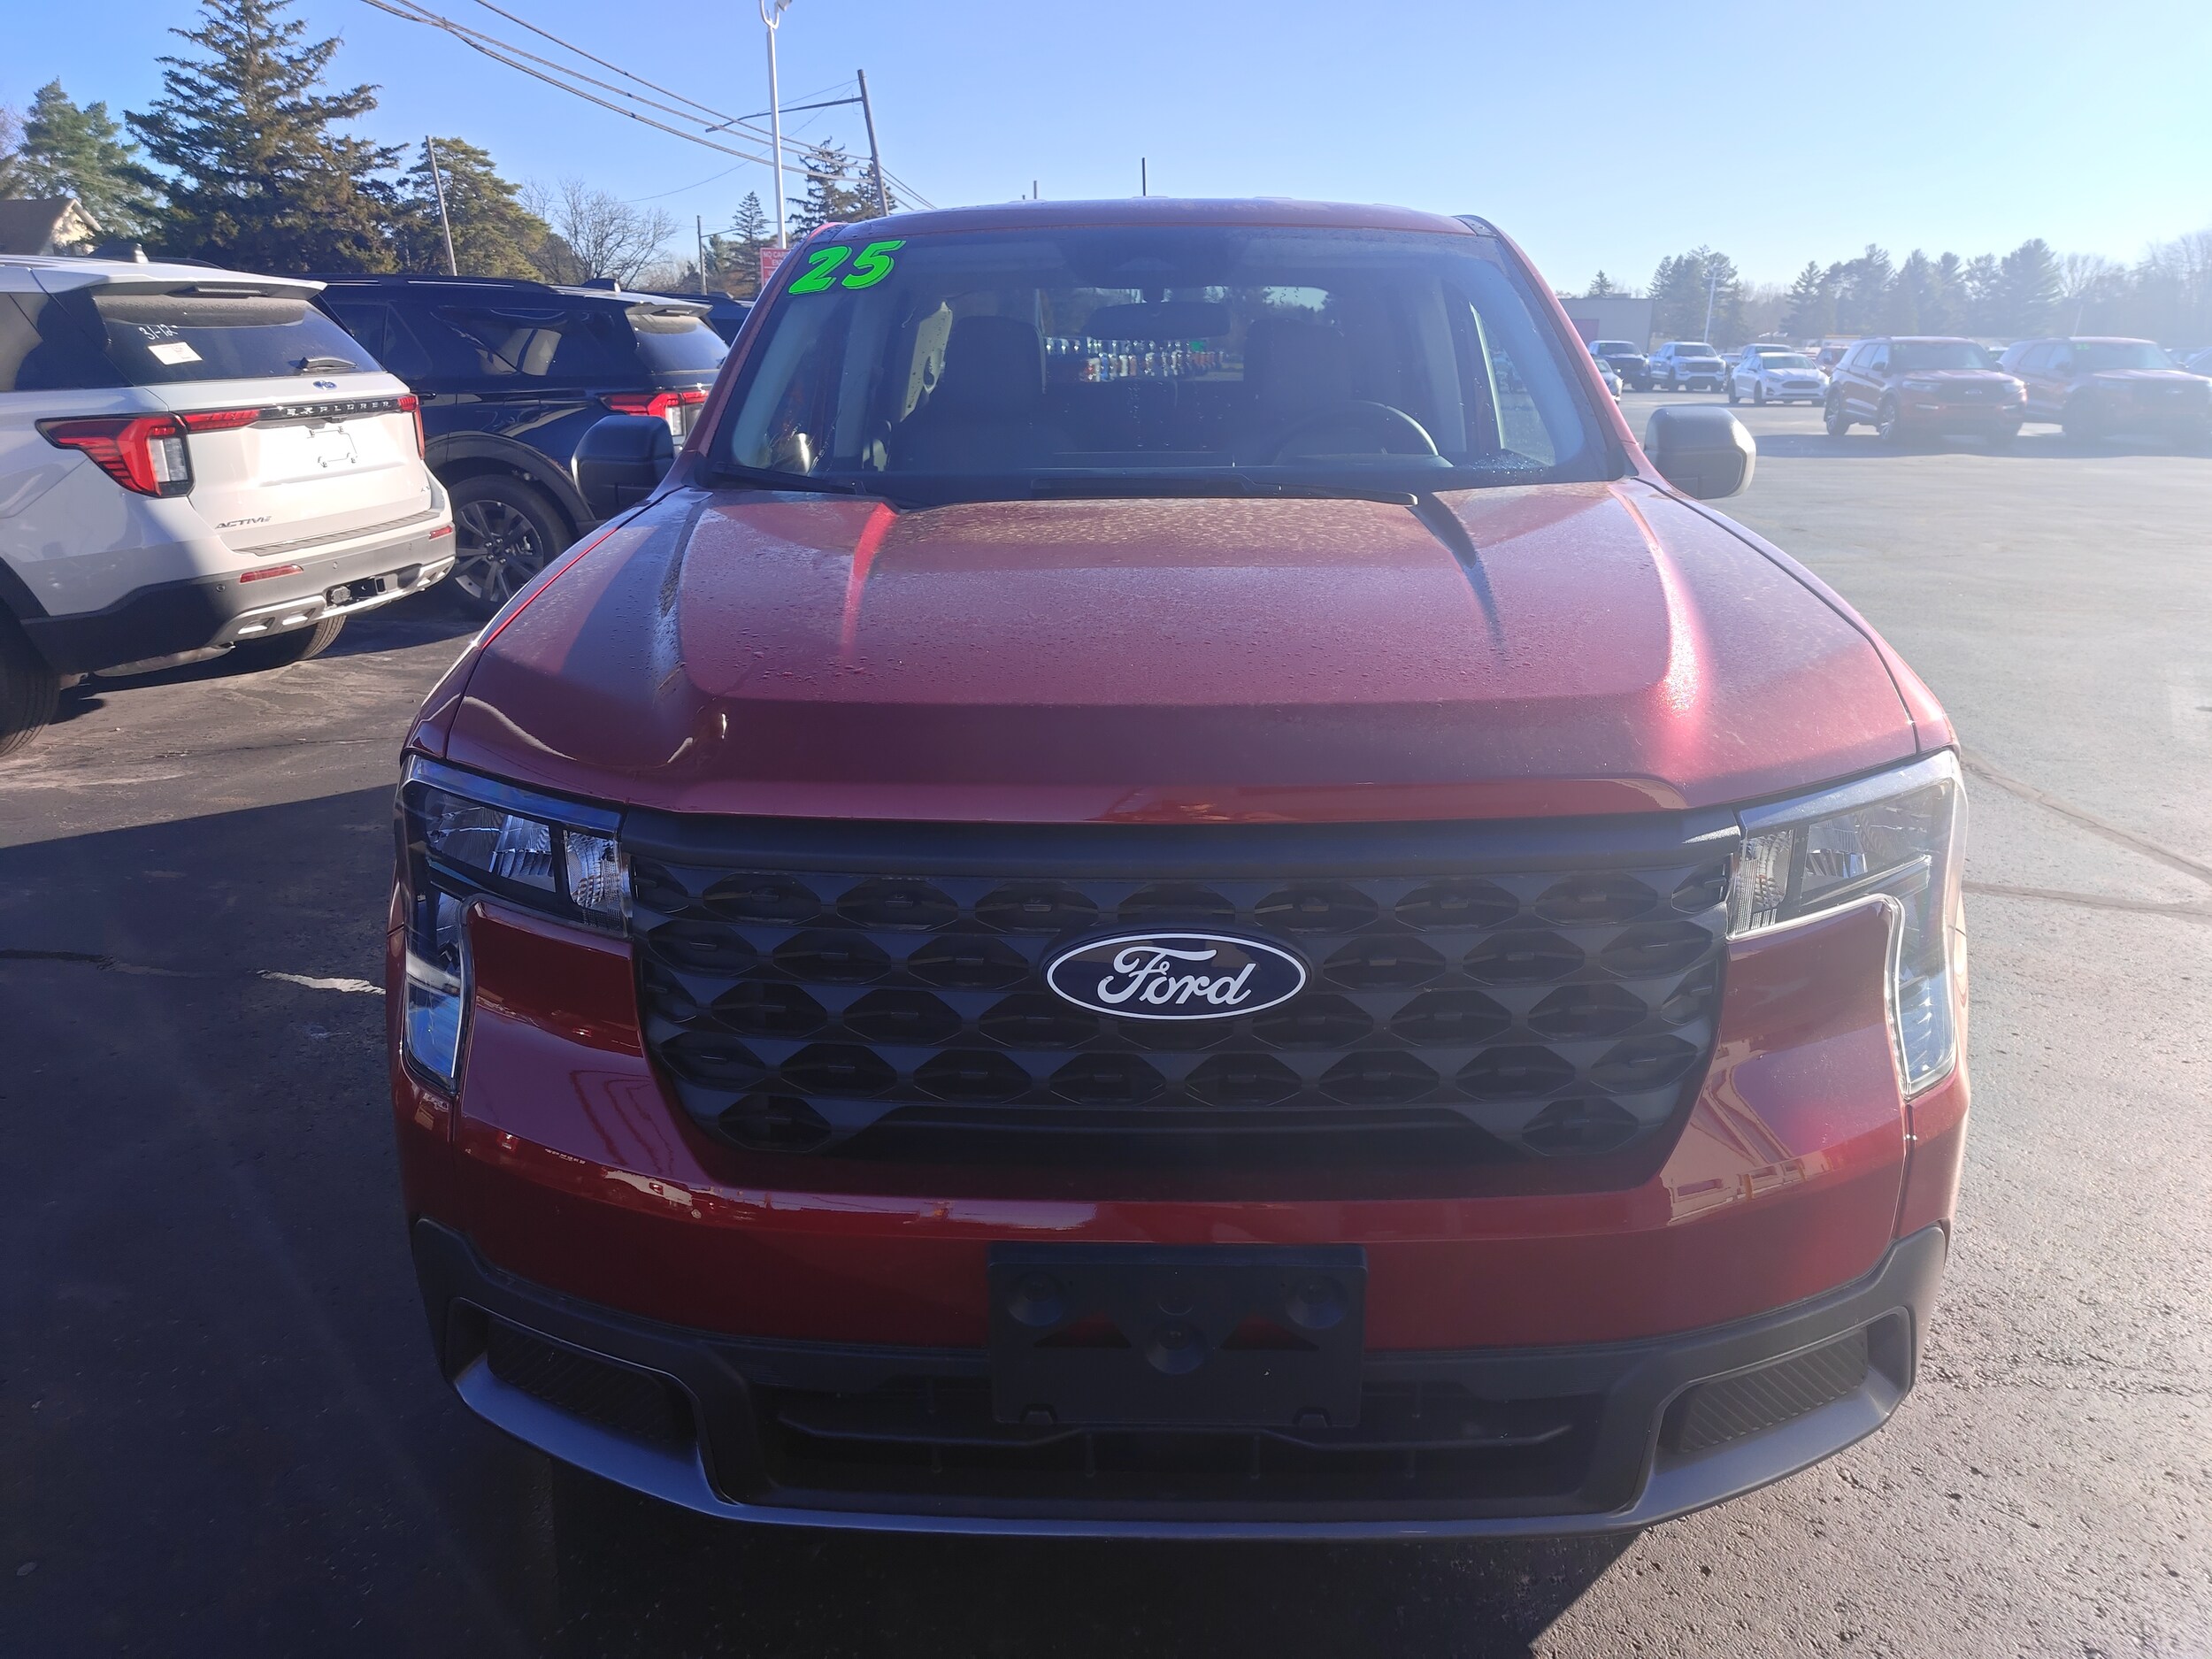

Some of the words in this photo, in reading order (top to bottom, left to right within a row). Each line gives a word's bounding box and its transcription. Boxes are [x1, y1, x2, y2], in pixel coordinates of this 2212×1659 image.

[788, 240, 907, 295] 25
[287, 401, 390, 416] EXPLORER
[214, 516, 272, 529] ACTIVE
[1097, 946, 1256, 1005] Ford
